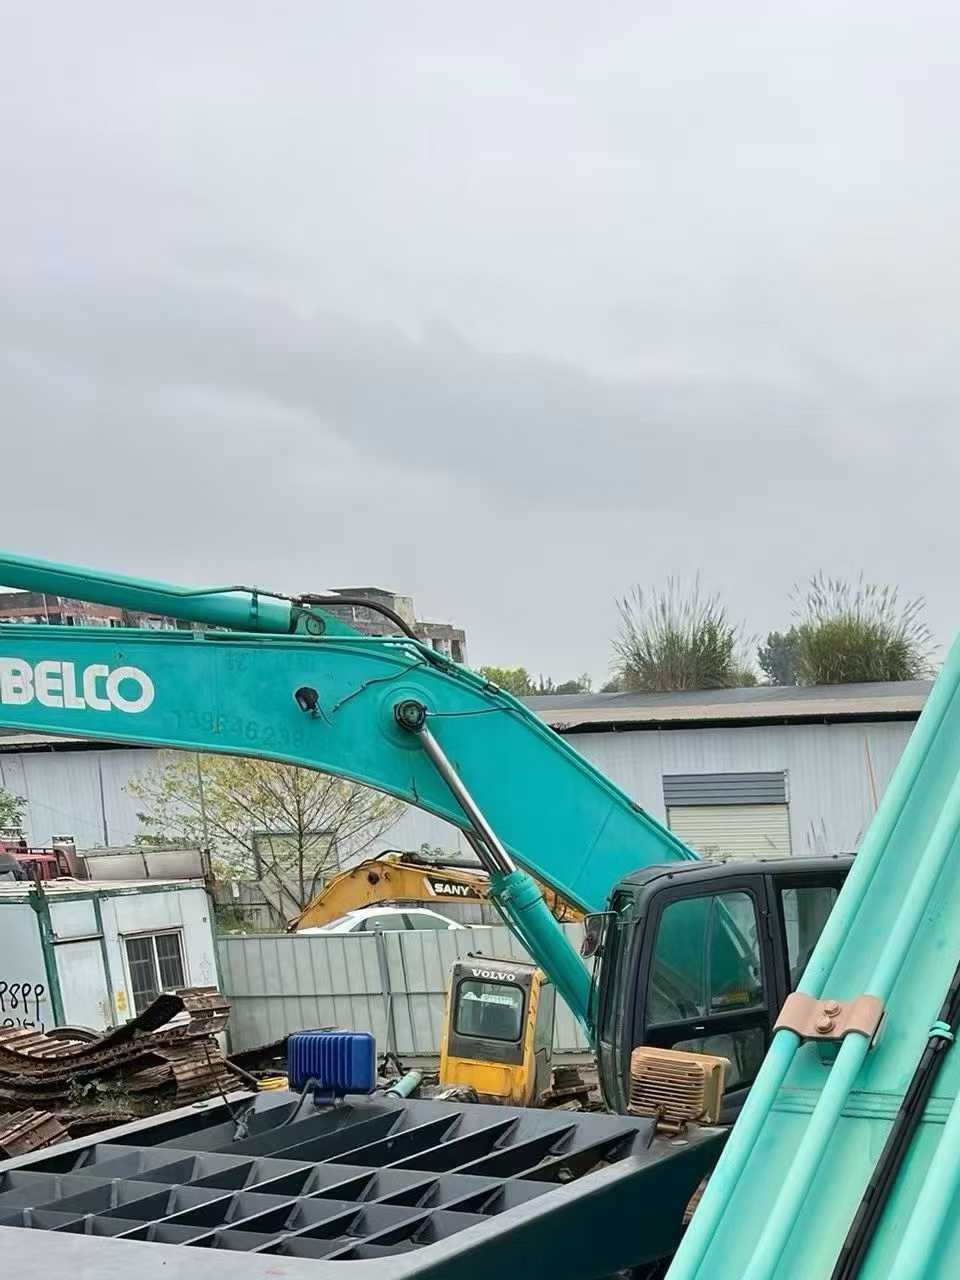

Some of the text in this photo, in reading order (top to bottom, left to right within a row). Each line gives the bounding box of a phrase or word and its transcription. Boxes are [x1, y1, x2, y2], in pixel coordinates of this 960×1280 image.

[0, 657, 155, 713] BELCO
[434, 883, 470, 896] SANY
[471, 968, 516, 981] VOLVO
